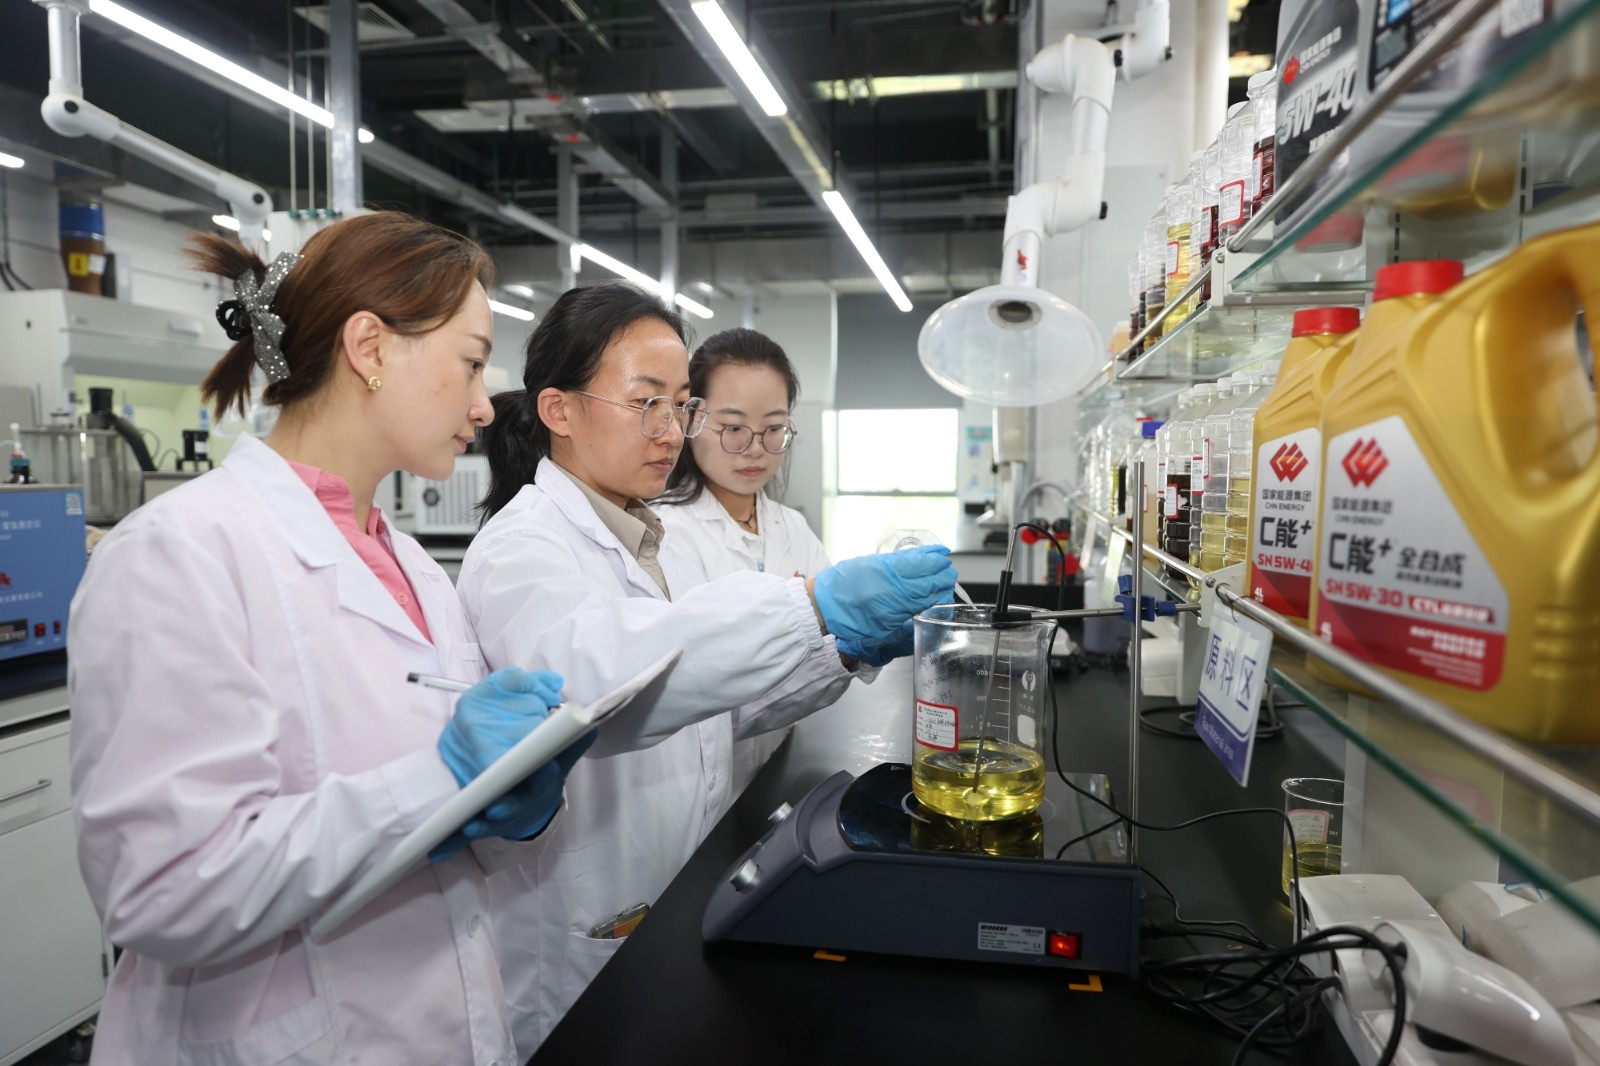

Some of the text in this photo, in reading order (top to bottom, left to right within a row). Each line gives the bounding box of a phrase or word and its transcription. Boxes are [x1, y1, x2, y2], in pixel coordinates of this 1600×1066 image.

[1278, 65, 1357, 145] 5W-40
[1262, 489, 1311, 502] 国家能源集团
[1265, 502, 1305, 511] CHN ENERGY
[1258, 553, 1313, 573] SN 5W-4
[1345, 582, 1403, 608] 5W-30
[1206, 633, 1257, 712] 原料区
